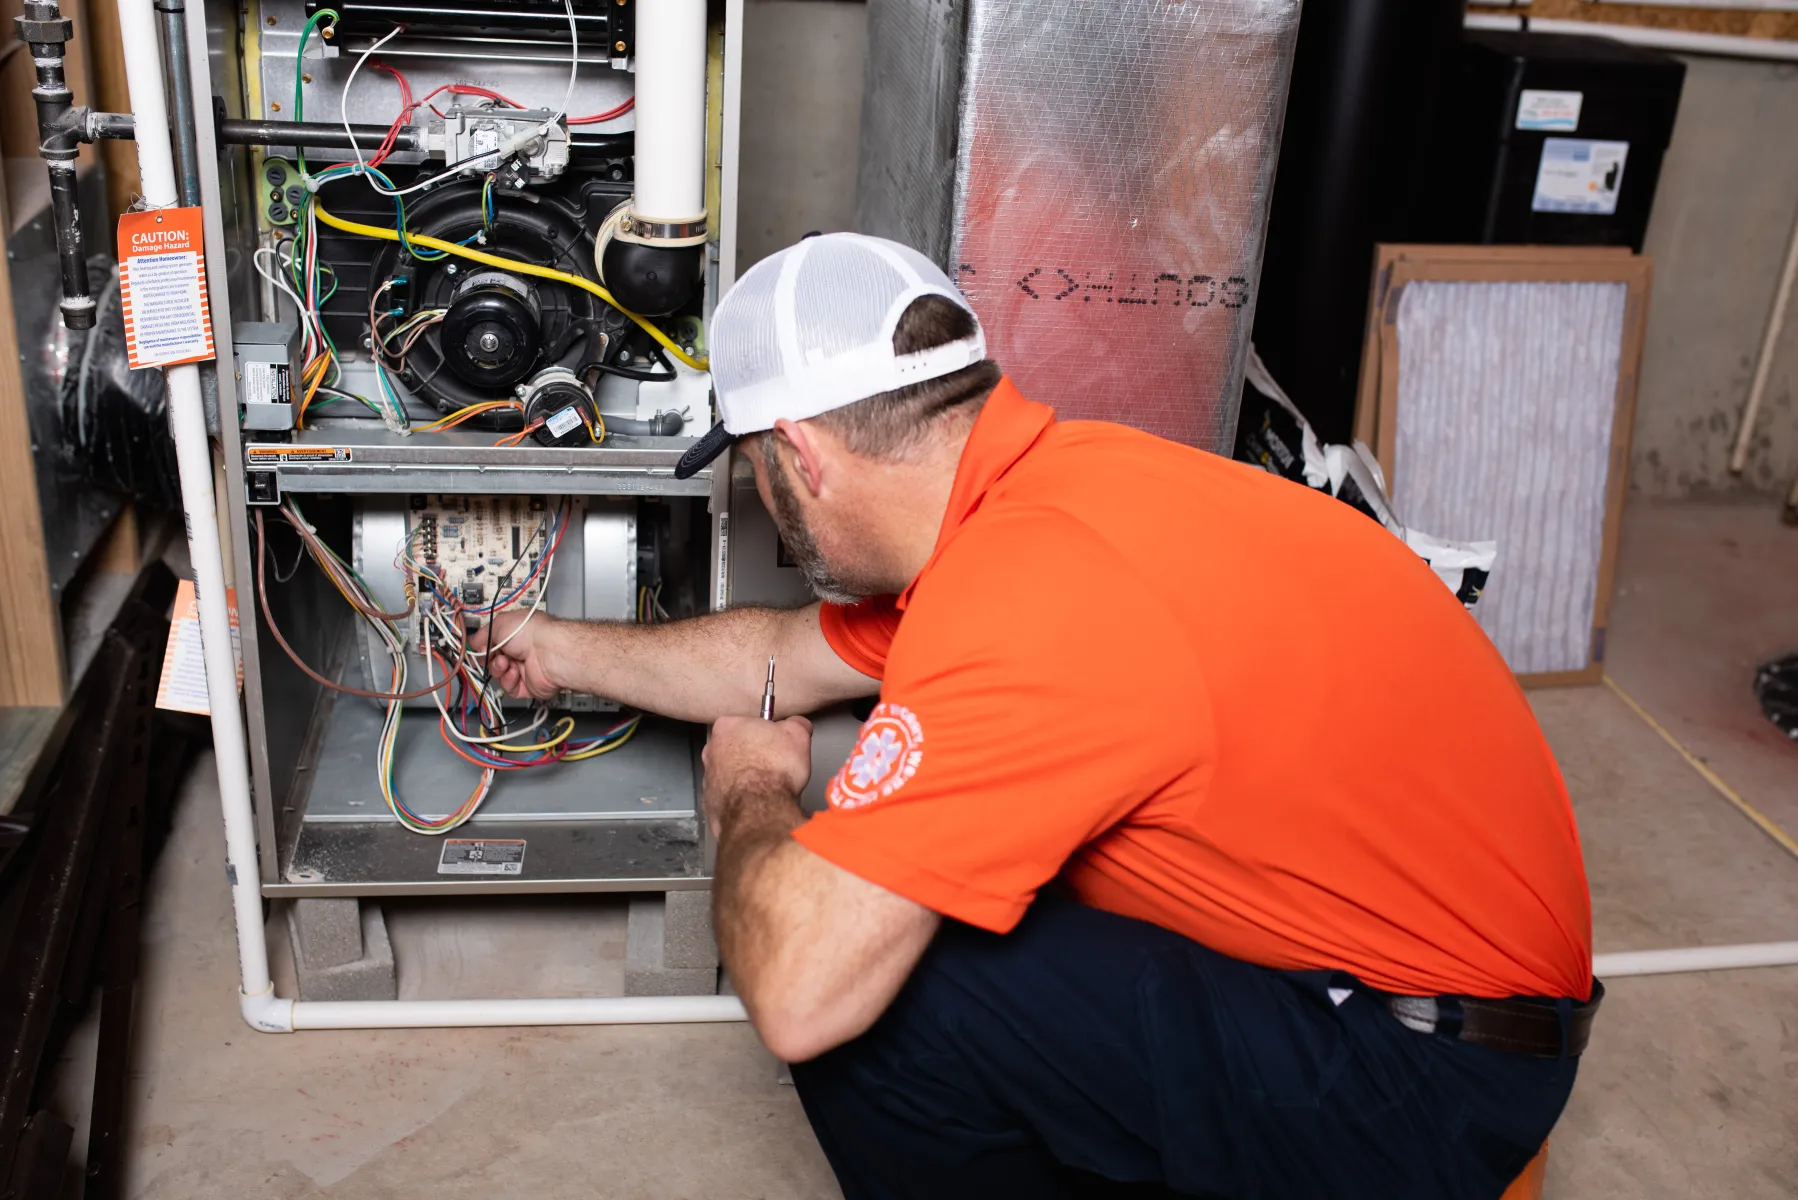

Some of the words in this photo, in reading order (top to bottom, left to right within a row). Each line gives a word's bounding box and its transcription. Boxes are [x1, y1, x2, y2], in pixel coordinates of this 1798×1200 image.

[510, 159, 522, 171] OFF
[132, 230, 189, 244] CAUTION:
[132, 244, 163, 253] Damage
[163, 240, 190, 250] Hazard
